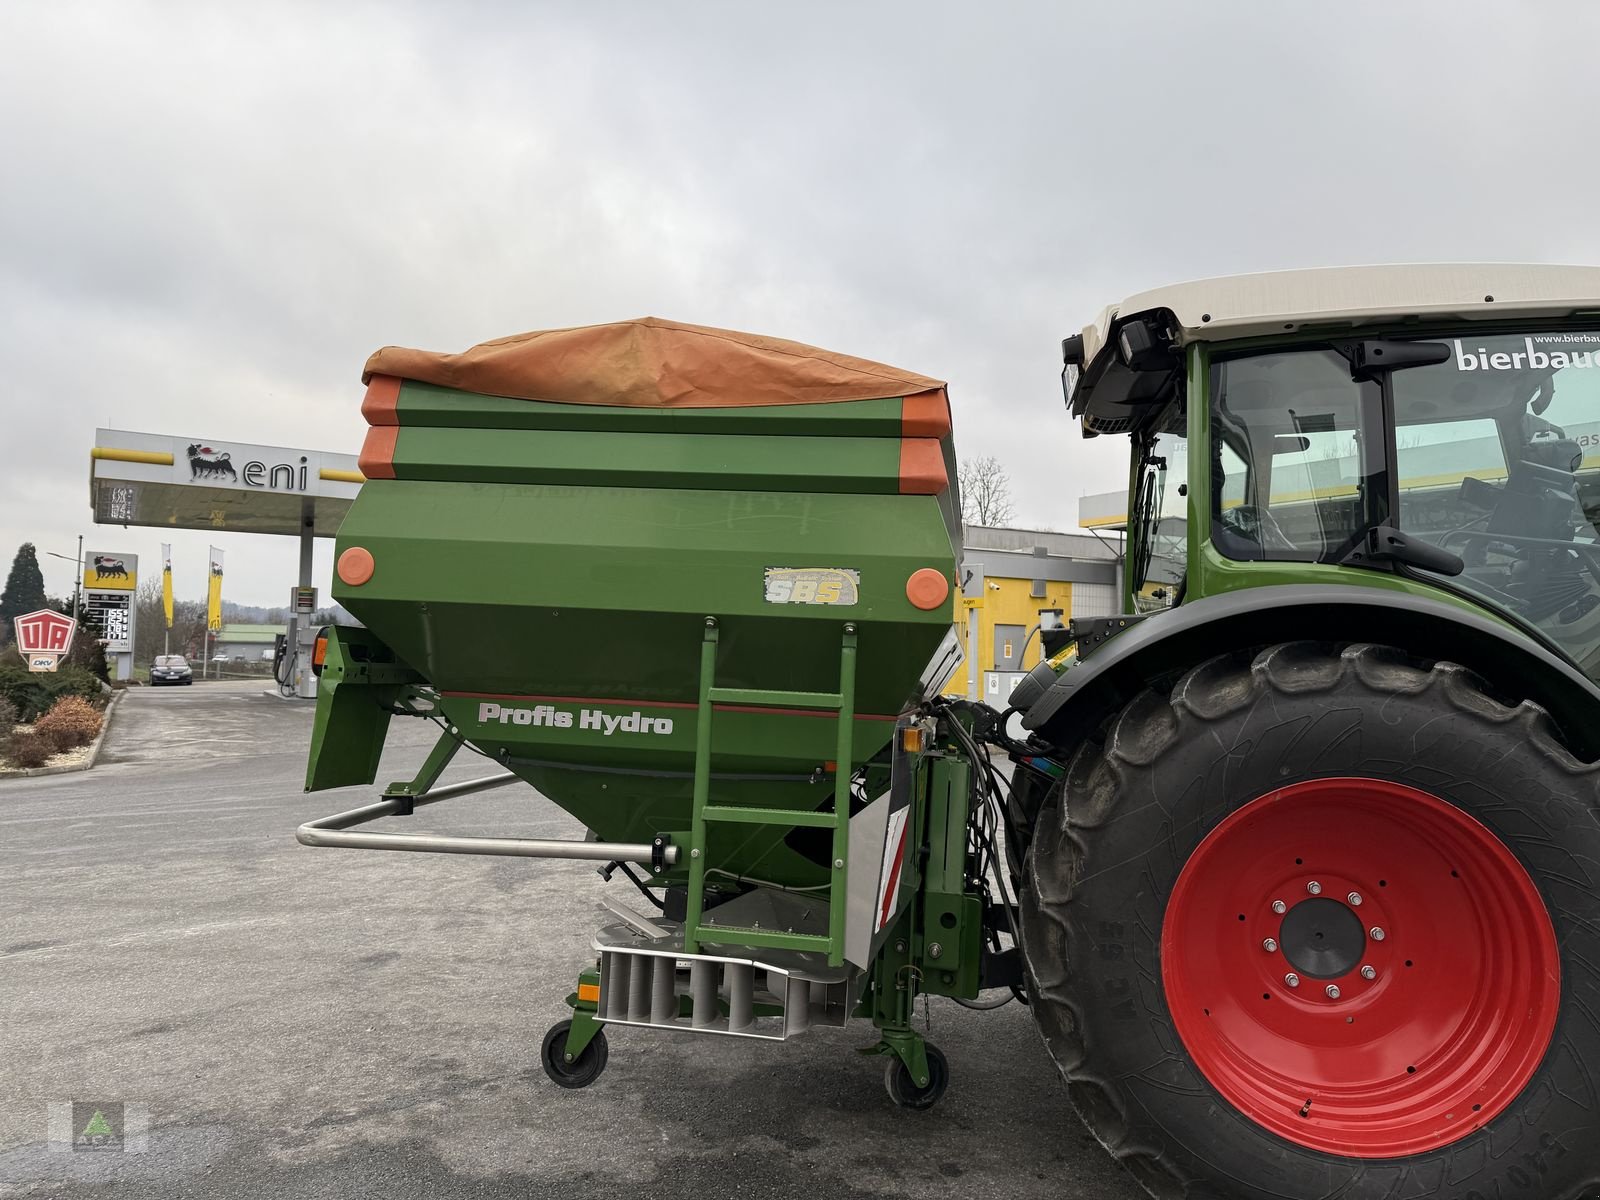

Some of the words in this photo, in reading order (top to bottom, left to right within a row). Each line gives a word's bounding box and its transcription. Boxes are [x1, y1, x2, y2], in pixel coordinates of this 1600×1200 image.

[243, 456, 307, 491] eni
[765, 580, 843, 603] SBS
[20, 612, 70, 649] UTA
[478, 702, 573, 728] Profis
[579, 709, 674, 735] Hydro
